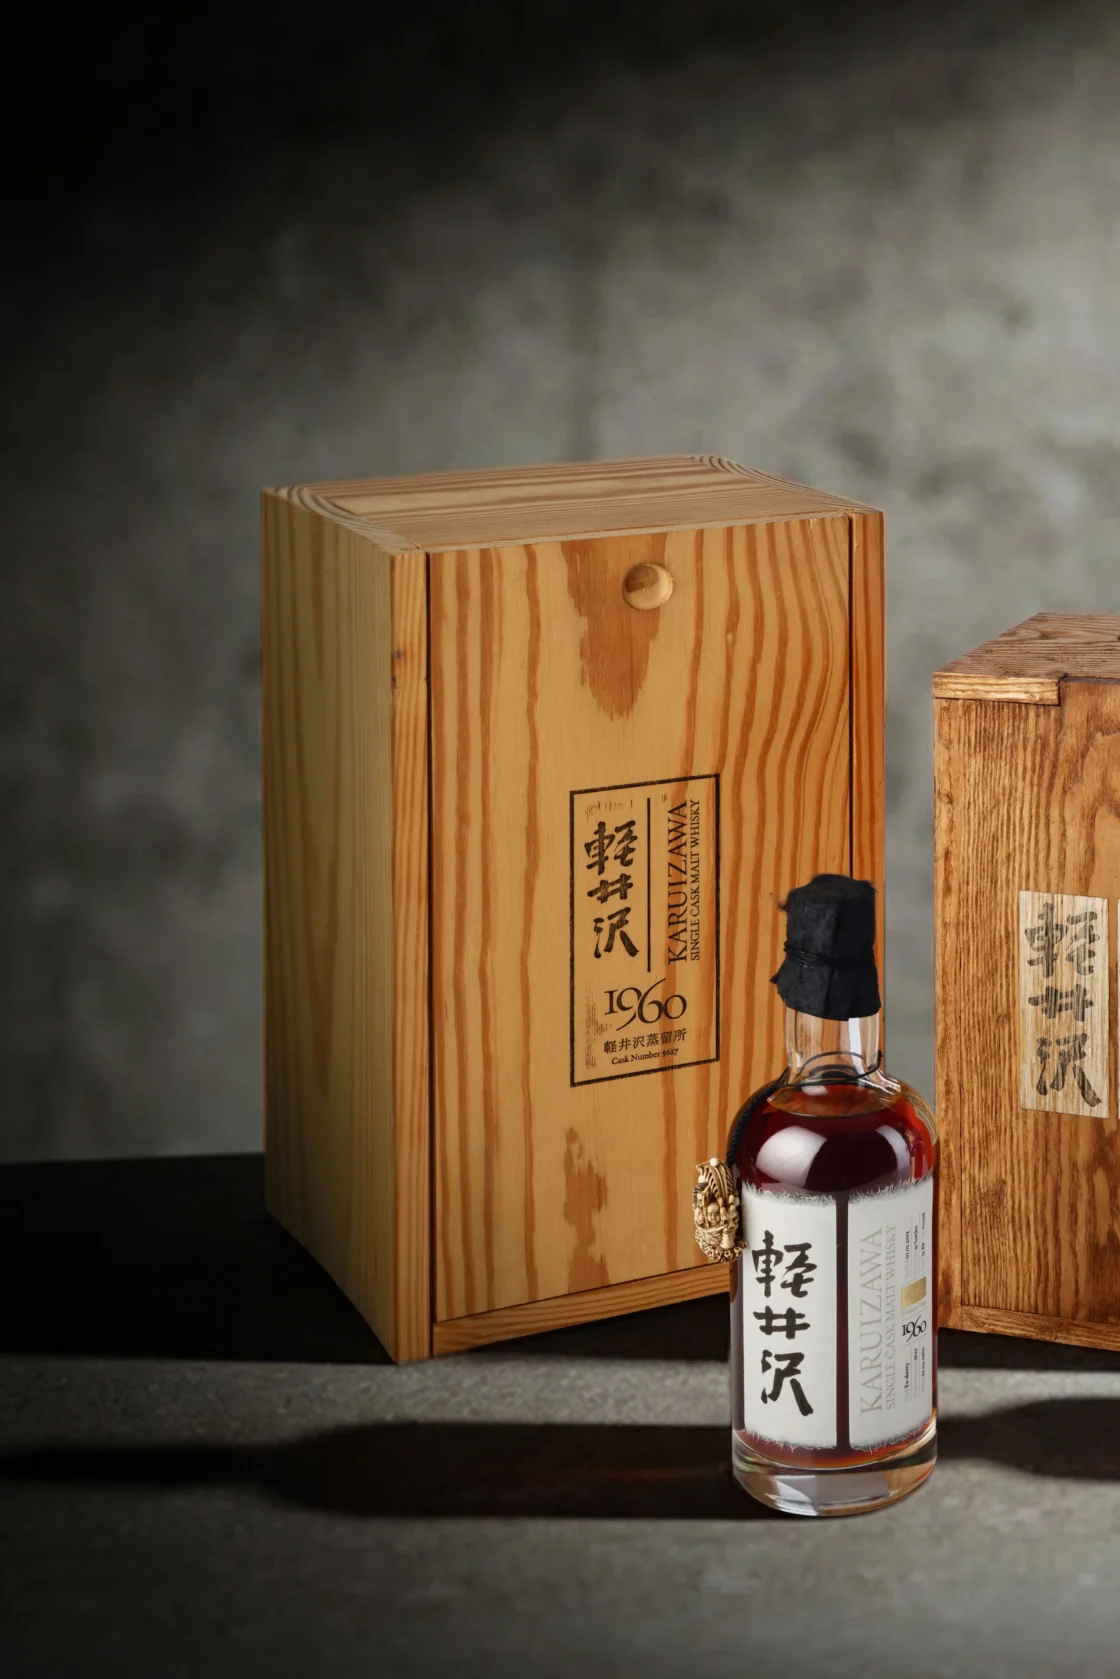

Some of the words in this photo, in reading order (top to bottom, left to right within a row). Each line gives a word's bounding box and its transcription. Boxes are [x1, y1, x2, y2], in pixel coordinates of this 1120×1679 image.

[690, 799, 700, 849] WHISKY
[584, 819, 640, 959] 軽井沢
[667, 799, 688, 966] KARUIZAWA
[690, 851, 700, 884] MALT
[690, 885, 700, 917] CASK
[690, 919, 700, 961] SINGLE
[603, 977, 688, 1032] 1960
[611, 1055, 629, 1066] Cask
[631, 1050, 661, 1062] Number
[886, 1225, 895, 1281] WHISKY
[752, 1229, 817, 1417] 軽井沢
[860, 1226, 882, 1416] KARUIZAWA
[886, 1284, 895, 1321] MALT
[886, 1324, 895, 1359] CASK
[901, 1314, 927, 1343] 1960
[886, 1362, 895, 1410] SINGLE
